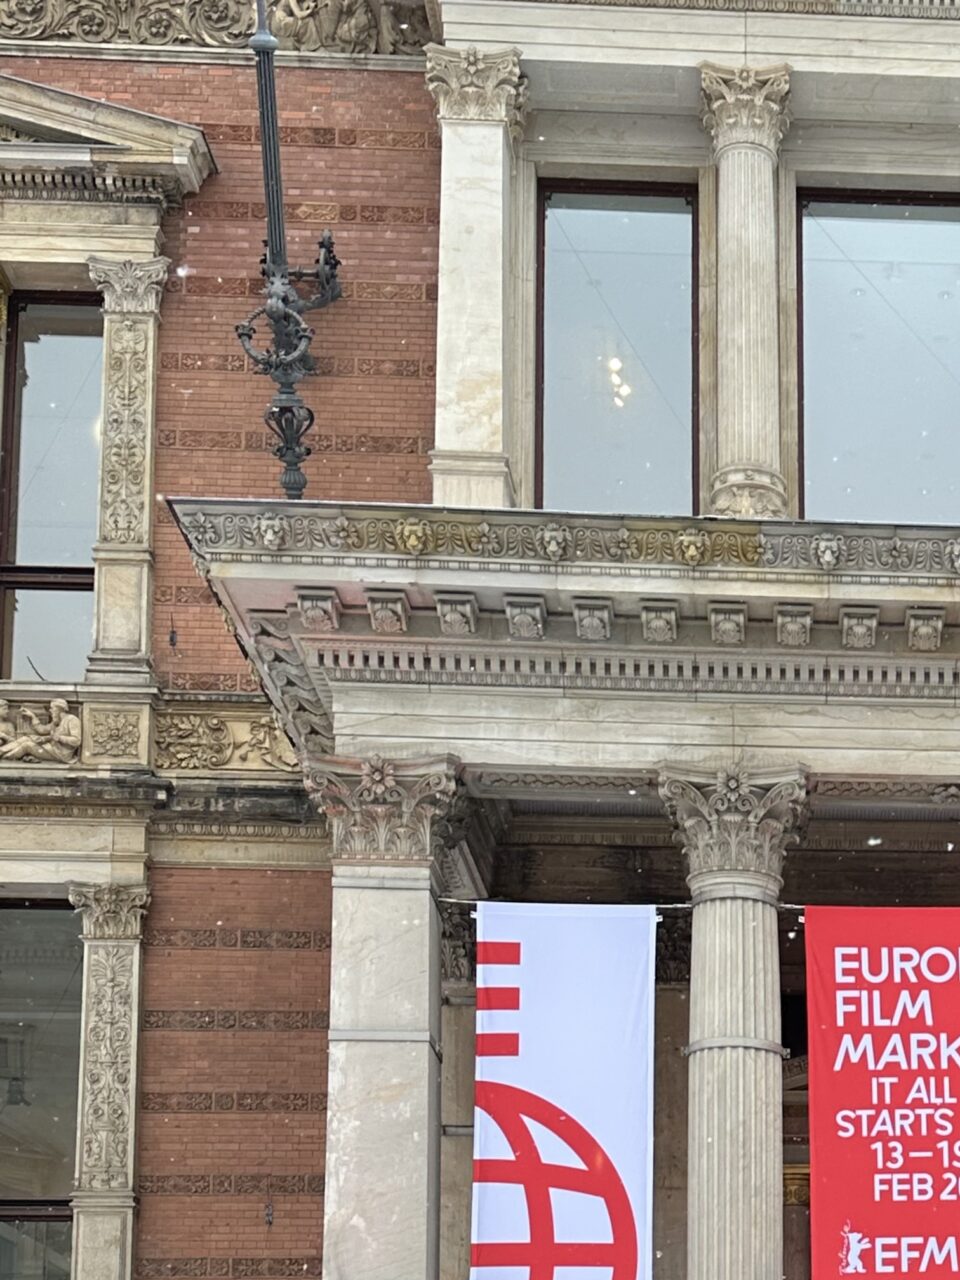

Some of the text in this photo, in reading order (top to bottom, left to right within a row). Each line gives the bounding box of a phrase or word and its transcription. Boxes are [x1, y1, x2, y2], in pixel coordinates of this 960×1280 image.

[835, 989, 934, 1027] FILM
[870, 1076, 957, 1105] IT ALL
[835, 1108, 954, 1138] STARTS
[873, 1173, 933, 1202] FEB
[874, 1236, 959, 1273] EFM
